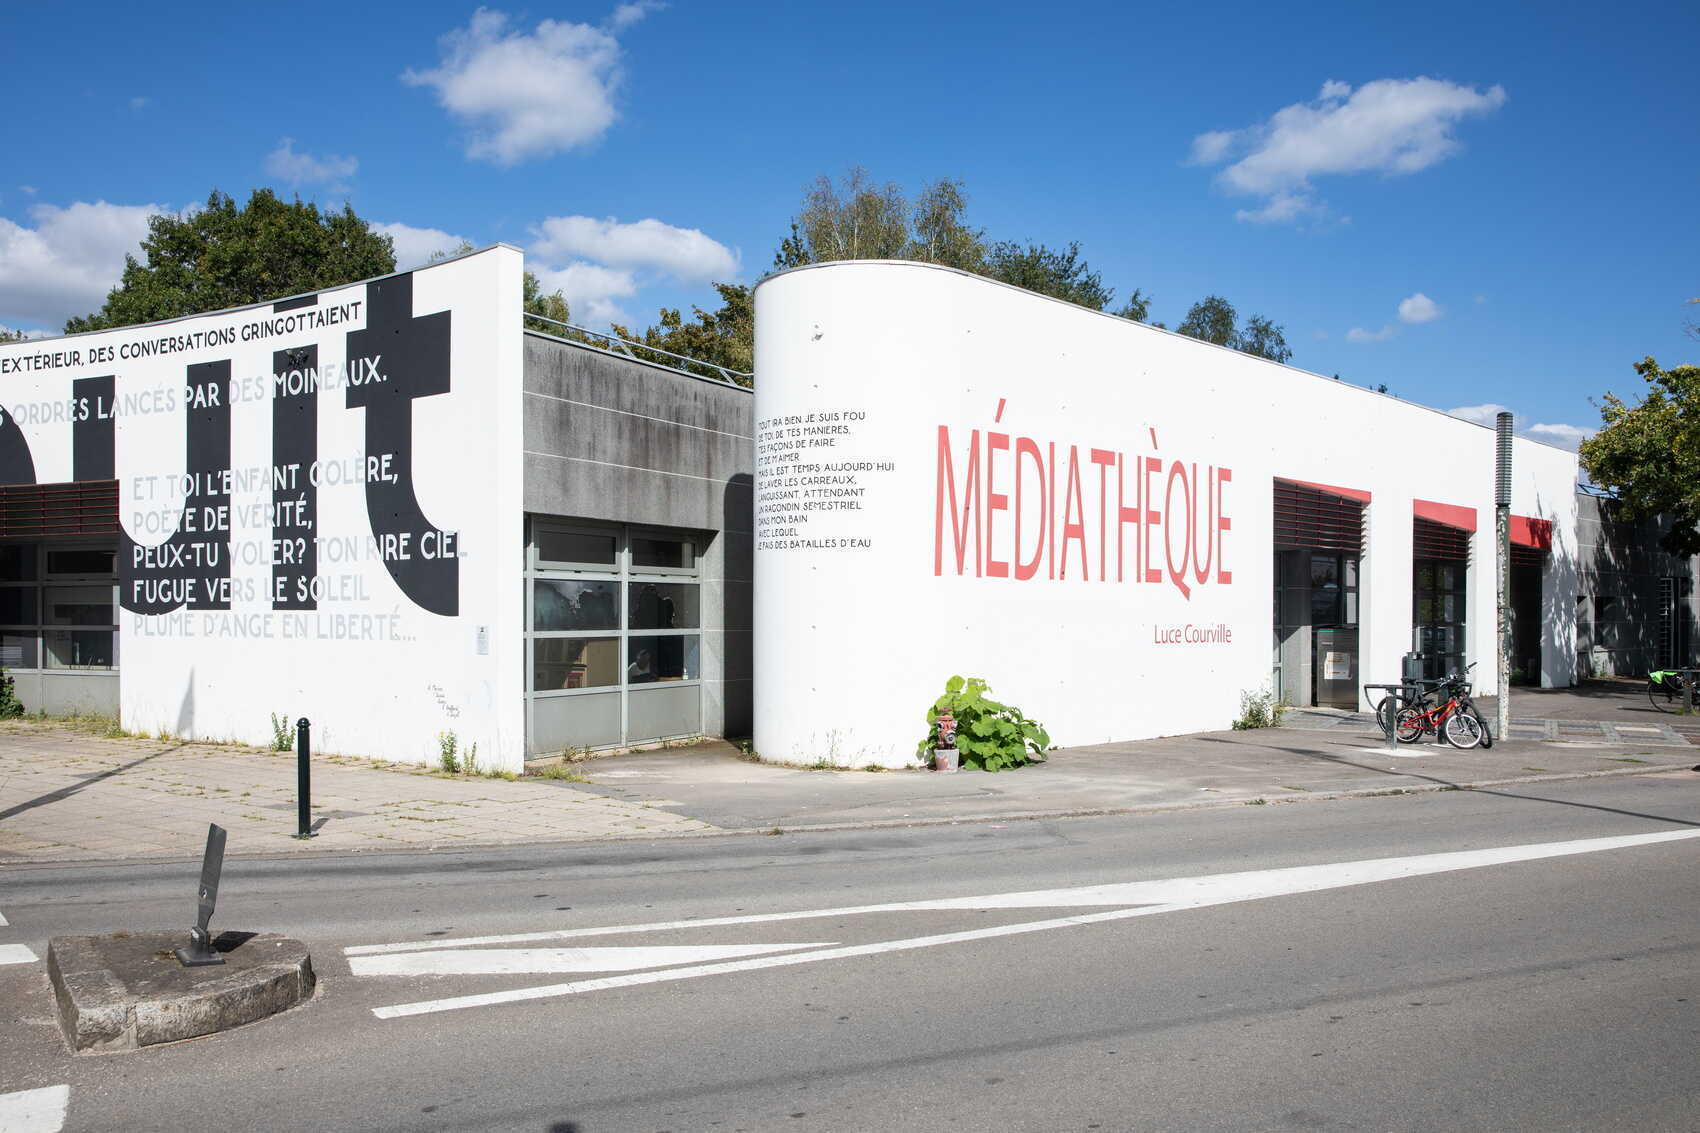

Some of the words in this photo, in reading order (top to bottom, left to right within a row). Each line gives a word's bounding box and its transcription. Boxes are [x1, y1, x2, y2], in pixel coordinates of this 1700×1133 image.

[1, 350, 85, 374] EXTÉRIEUR,
[89, 346, 115, 364] DES
[120, 327, 236, 360] CONVERSATIONS
[241, 301, 362, 342] GRINGOTTAIENT
[13, 397, 90, 426] ORDRES
[97, 382, 176, 419] LANCÉS
[185, 382, 220, 409] PAR
[229, 376, 265, 405] DES
[273, 355, 388, 398] MOINEAUX.
[785, 416, 802, 425] BIEN
[805, 414, 815, 422] JE
[819, 412, 840, 422] SUIS
[843, 411, 866, 421] FOU
[775, 430, 783, 439] DE
[786, 428, 801, 437] TES
[767, 440, 794, 453] FAÇONS
[795, 439, 807, 449] DE
[809, 438, 836, 448] FAIRE
[133, 476, 158, 500] ET
[165, 472, 200, 498] TOI
[207, 464, 300, 496] L'ENFANT
[309, 448, 399, 488] COLÈRE,
[776, 465, 789, 475] EST
[792, 463, 821, 473] TEMPS
[824, 462, 895, 472] AUJOURD'HUI
[784, 477, 798, 487] LES
[800, 475, 857, 486] CARREAUX,
[803, 488, 866, 499] ATTENDANT
[934, 398, 1232, 601] MÉDIATHÈQUE
[133, 503, 196, 535] POÈTE
[204, 505, 229, 532] DE
[237, 492, 312, 529] VÉRITÉ,
[802, 501, 863, 511] SEMESTRIEL
[771, 515, 786, 525] MON
[788, 514, 808, 523] BAIN
[771, 527, 798, 537] LEQUEL
[133, 542, 219, 568] PEUX-TU
[226, 537, 306, 566] VOLER?
[313, 535, 358, 563] TON
[366, 532, 411, 561] RIRE
[420, 529, 468, 560] CIEL
[774, 540, 787, 550] DES
[789, 539, 836, 550] BATAILLES
[840, 539, 871, 548] D'EAU
[133, 578, 197, 603] FUGUE
[205, 577, 255, 602] VERS
[264, 576, 288, 602] LE
[296, 575, 370, 602] SOLEIL
[133, 613, 195, 638] PLUME
[203, 612, 274, 639] D'ANGE
[282, 613, 308, 639] EN
[1154, 624, 1182, 643] Luce
[1184, 623, 1232, 643] Courville
